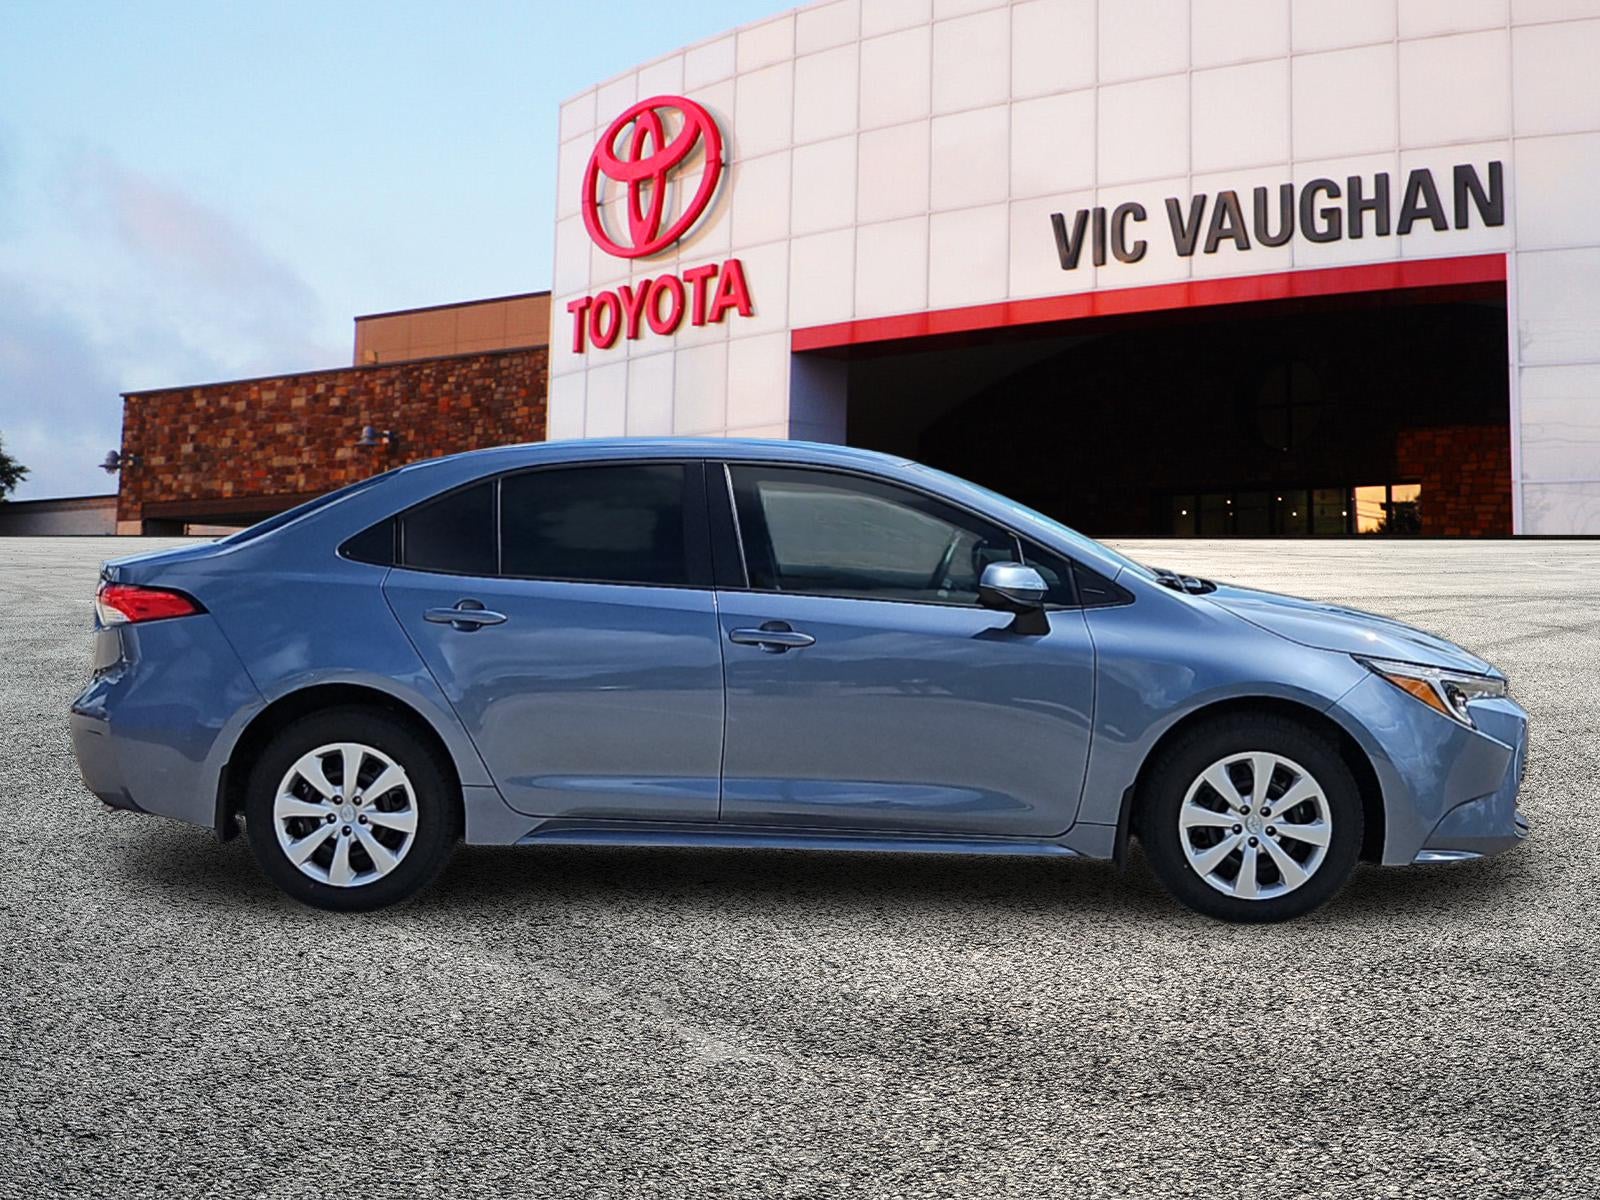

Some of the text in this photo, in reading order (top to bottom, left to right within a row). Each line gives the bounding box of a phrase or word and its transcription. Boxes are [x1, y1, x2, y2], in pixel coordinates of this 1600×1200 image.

[1050, 160, 1505, 271] VIC VAUGHAN
[567, 258, 754, 354] TOYOTA
